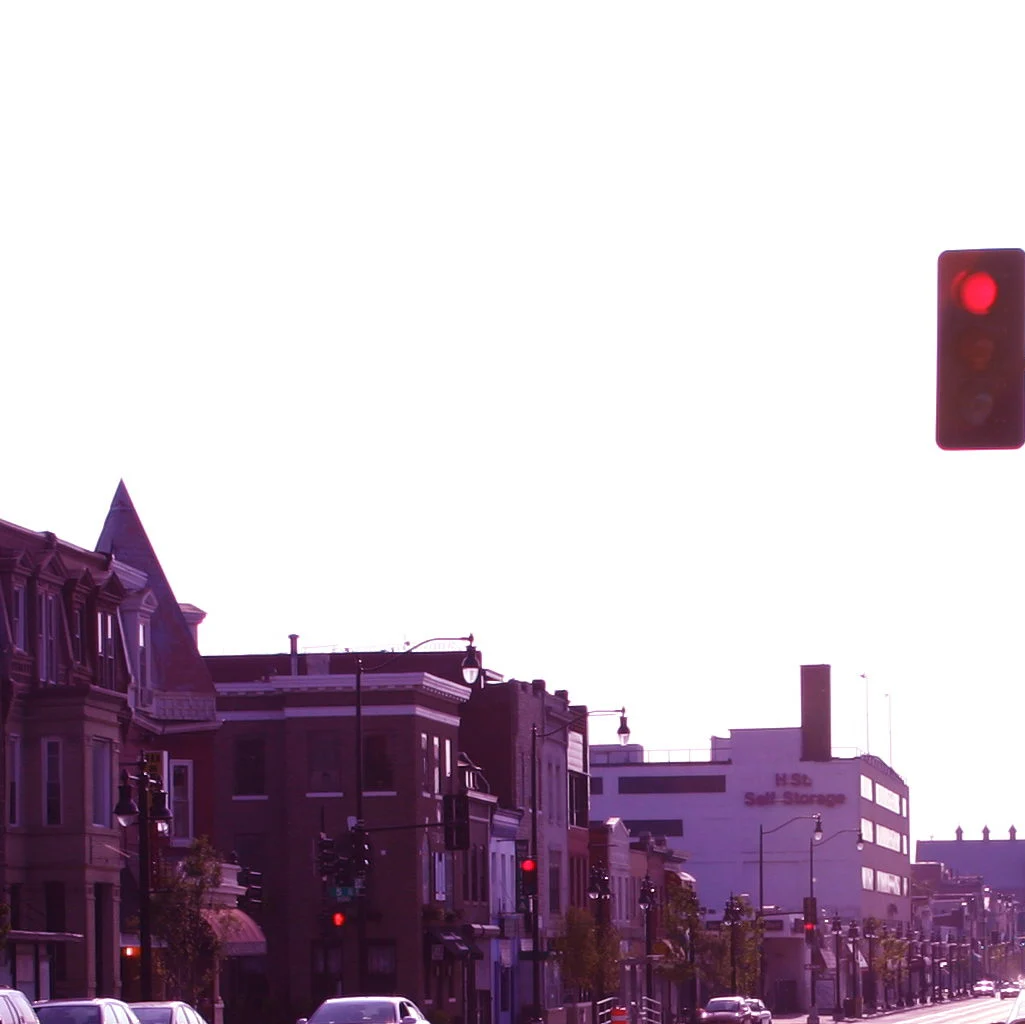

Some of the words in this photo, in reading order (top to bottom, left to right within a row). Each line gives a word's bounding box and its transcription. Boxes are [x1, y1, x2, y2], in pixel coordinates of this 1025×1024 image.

[775, 773, 786, 786] H
[744, 791, 776, 806] Self
[783, 791, 846, 808] Storage
